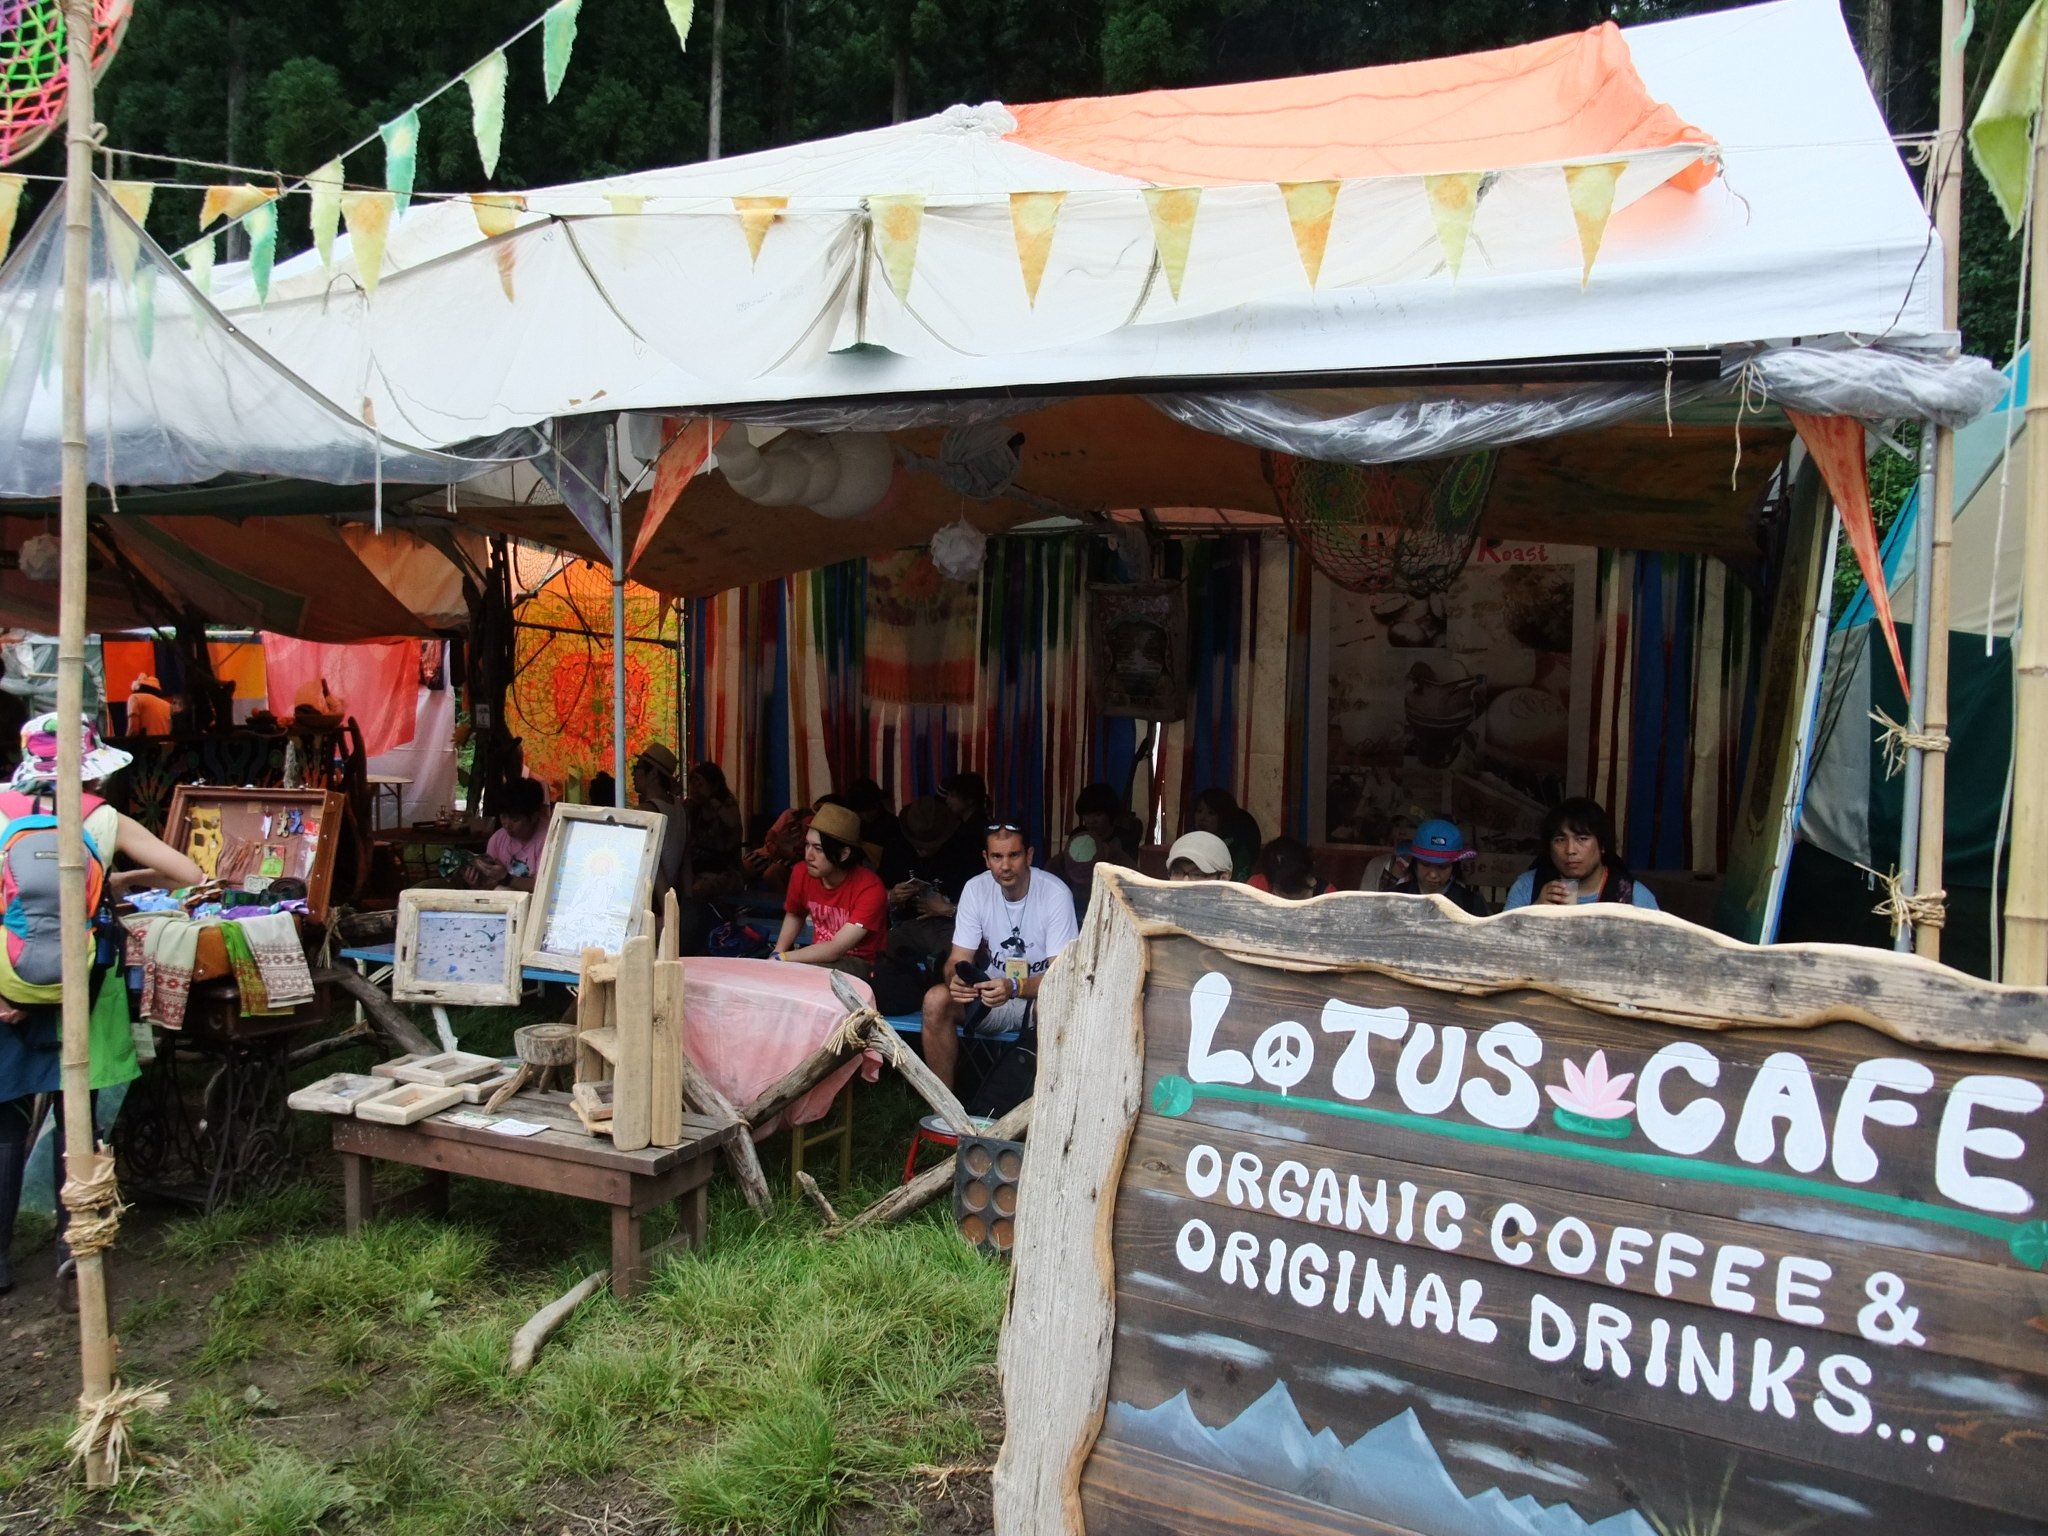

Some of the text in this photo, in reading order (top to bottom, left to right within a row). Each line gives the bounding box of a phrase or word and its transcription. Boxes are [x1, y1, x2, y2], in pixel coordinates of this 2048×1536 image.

[1476, 537, 1549, 563] Roast
[1187, 971, 2047, 1214] LOTUS CAFE
[1175, 1218, 1946, 1454] ORIGINAL DRINKS...
[1185, 1144, 1928, 1347] ORGANIC COFFEE &
